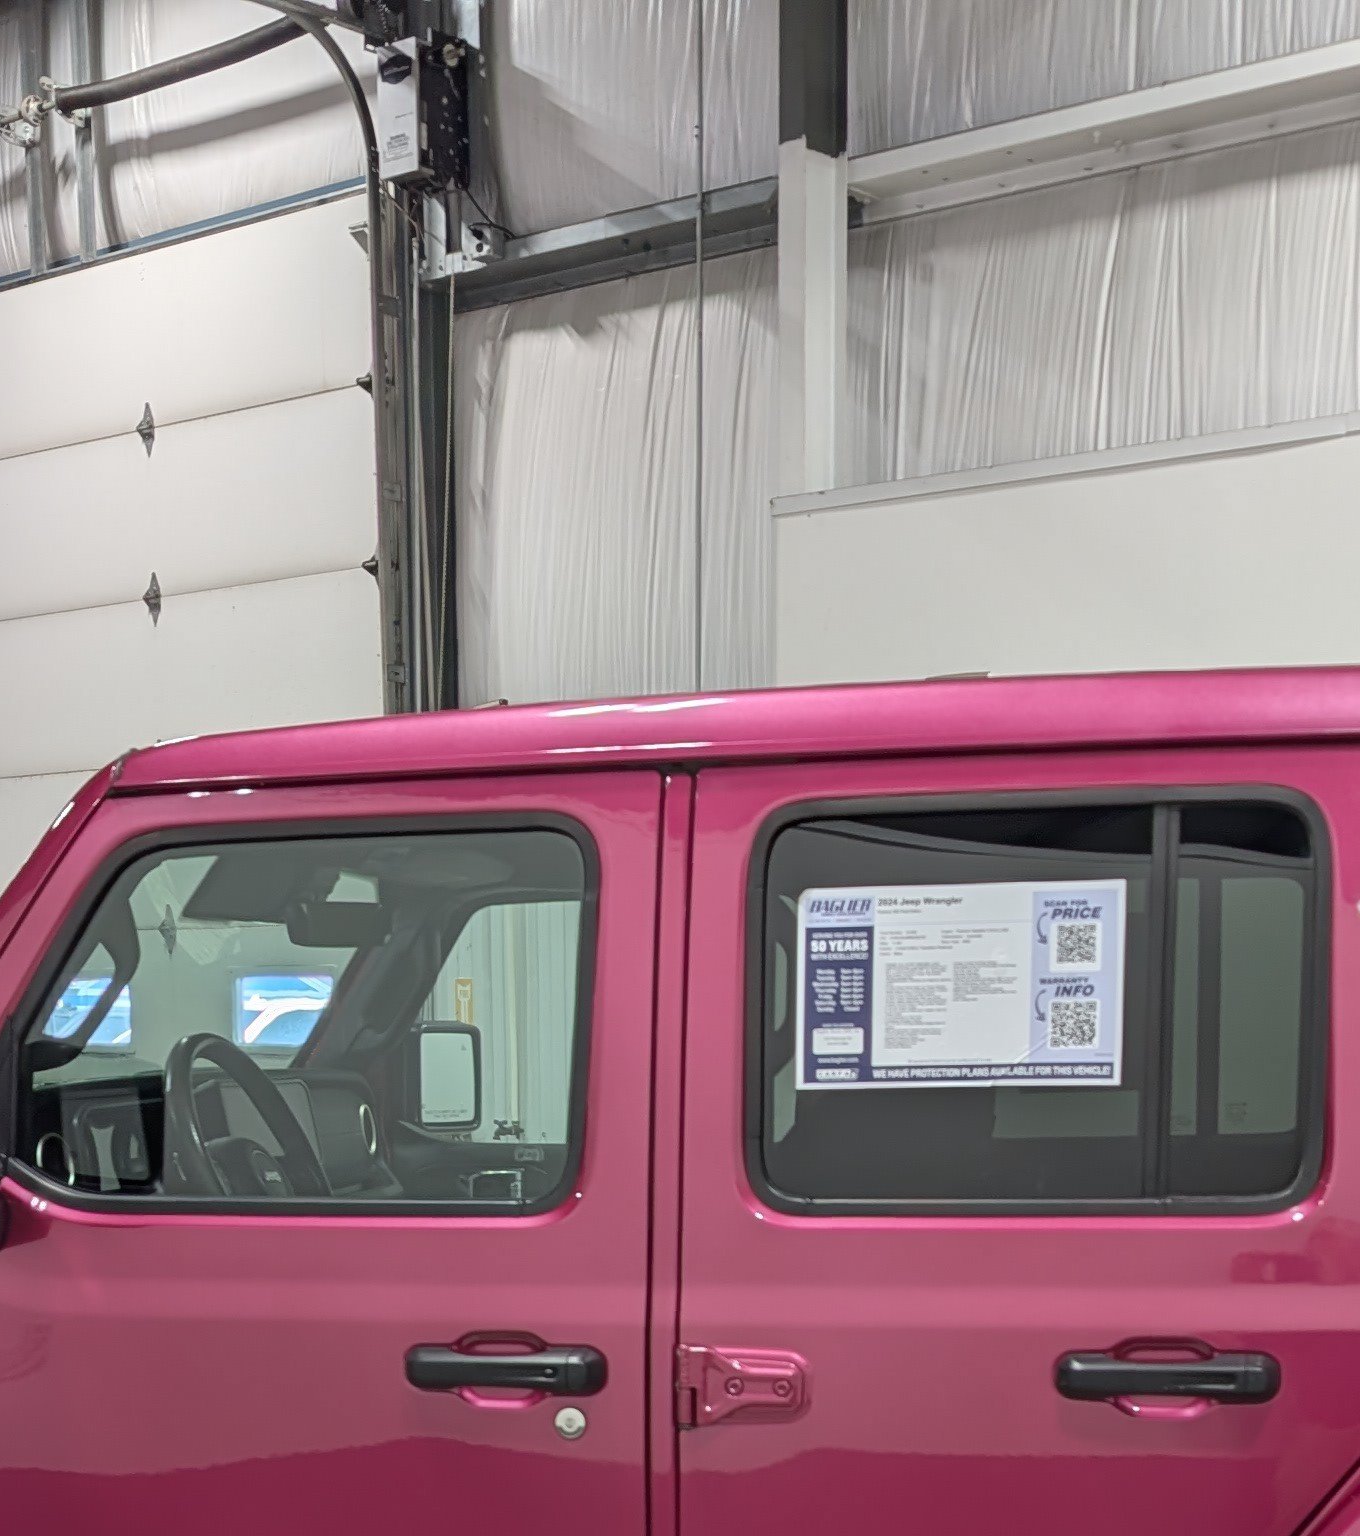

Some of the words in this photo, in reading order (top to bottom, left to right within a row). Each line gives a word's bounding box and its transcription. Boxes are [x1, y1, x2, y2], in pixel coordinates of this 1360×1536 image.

[878, 898, 898, 906] 2024
[900, 898, 921, 907] Jeep
[923, 896, 963, 906] Wrangler
[1051, 907, 1102, 919] PRICE
[828, 939, 869, 952] YEARS
[1054, 985, 1095, 997] INFO
[887, 1069, 909, 1078] HAVE
[910, 1068, 960, 1078] PROTECTION
[961, 1067, 989, 1077] PLANS
[1034, 1066, 1052, 1076] FOR
[1053, 1065, 1072, 1075] THIS
